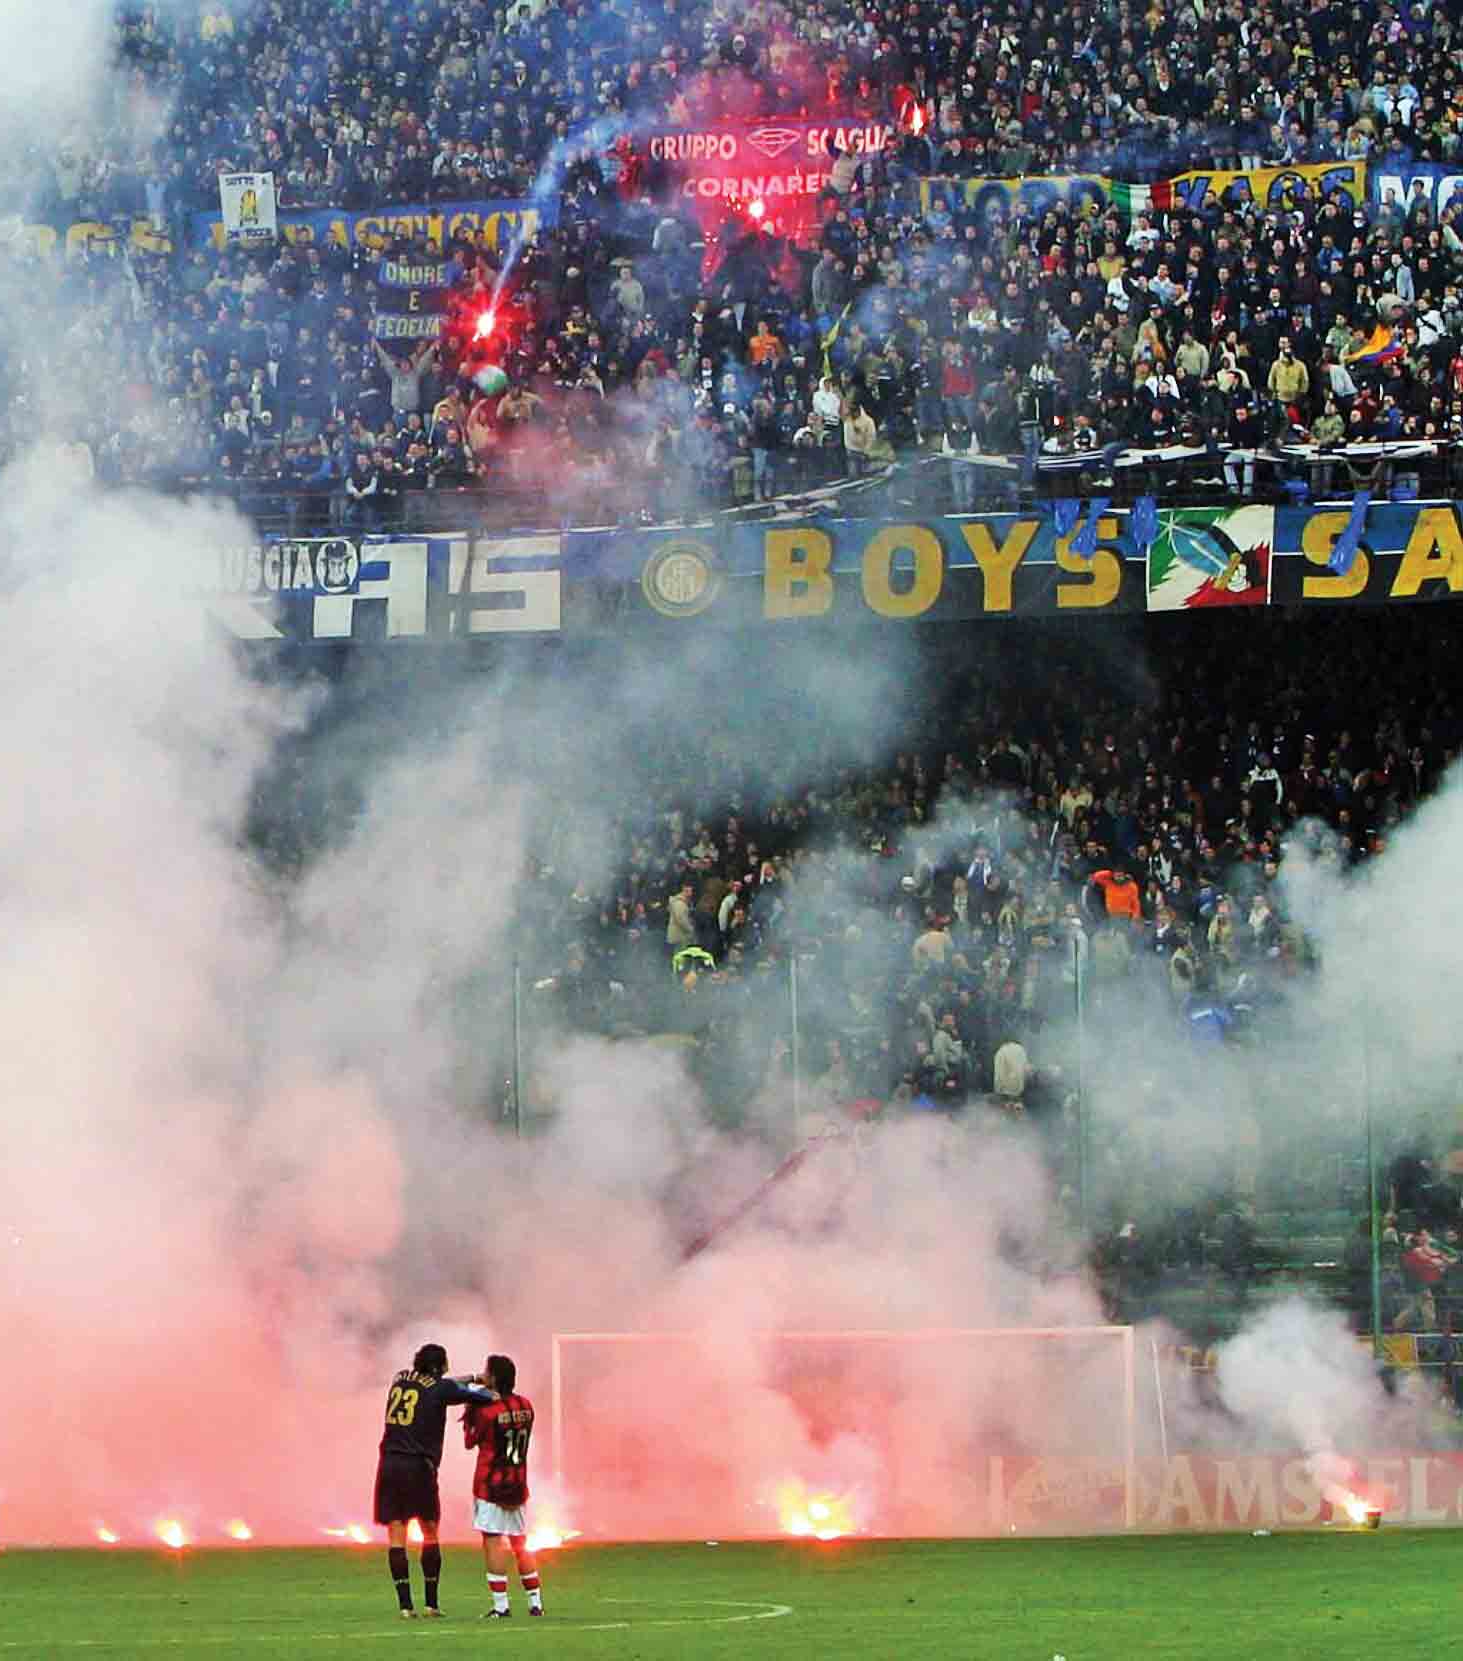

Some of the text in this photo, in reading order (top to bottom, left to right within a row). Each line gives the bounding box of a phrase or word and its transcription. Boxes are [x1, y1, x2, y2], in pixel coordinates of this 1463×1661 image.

[650, 133, 737, 161] GRUPPO
[682, 172, 833, 199] CORNARE
[385, 261, 447, 286] ONORE
[409, 291, 421, 312] E
[762, 507, 1463, 620] BOYS SA
[386, 1386, 420, 1426] 23
[1157, 1454, 1449, 1524] AMSEL
